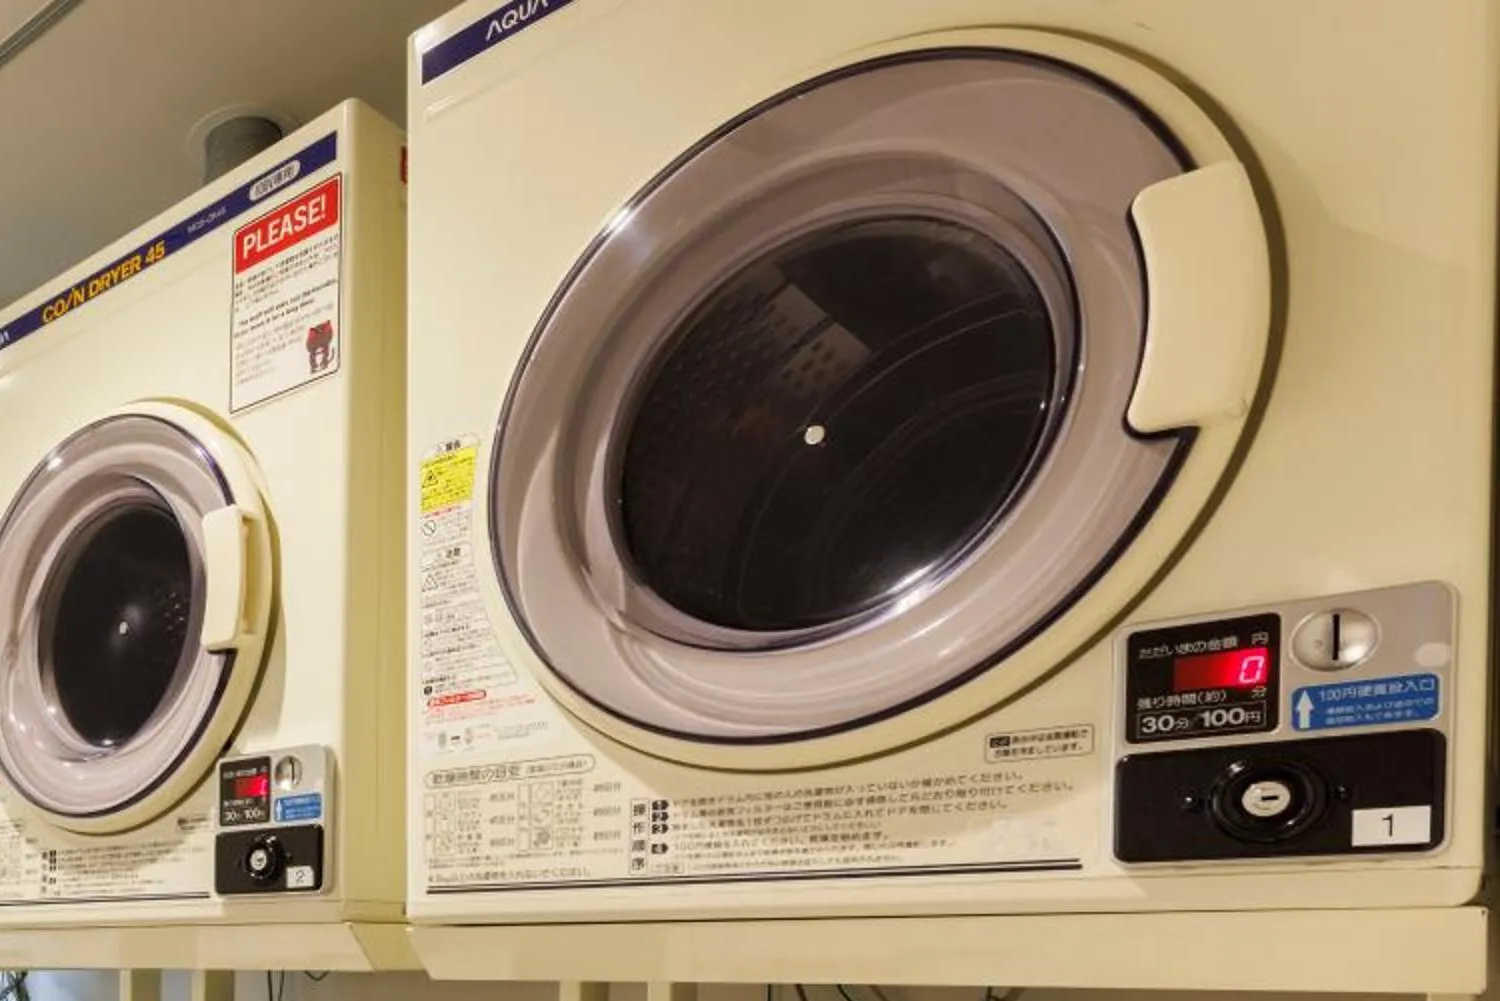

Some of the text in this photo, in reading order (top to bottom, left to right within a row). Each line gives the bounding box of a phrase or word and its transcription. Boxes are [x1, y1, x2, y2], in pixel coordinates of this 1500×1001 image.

[242, 193, 327, 261] PLEASE!
[87, 254, 141, 299] DRYER
[145, 240, 166, 266] 45
[1238, 655, 1266, 684] 0
[1381, 814, 1394, 837] 1
